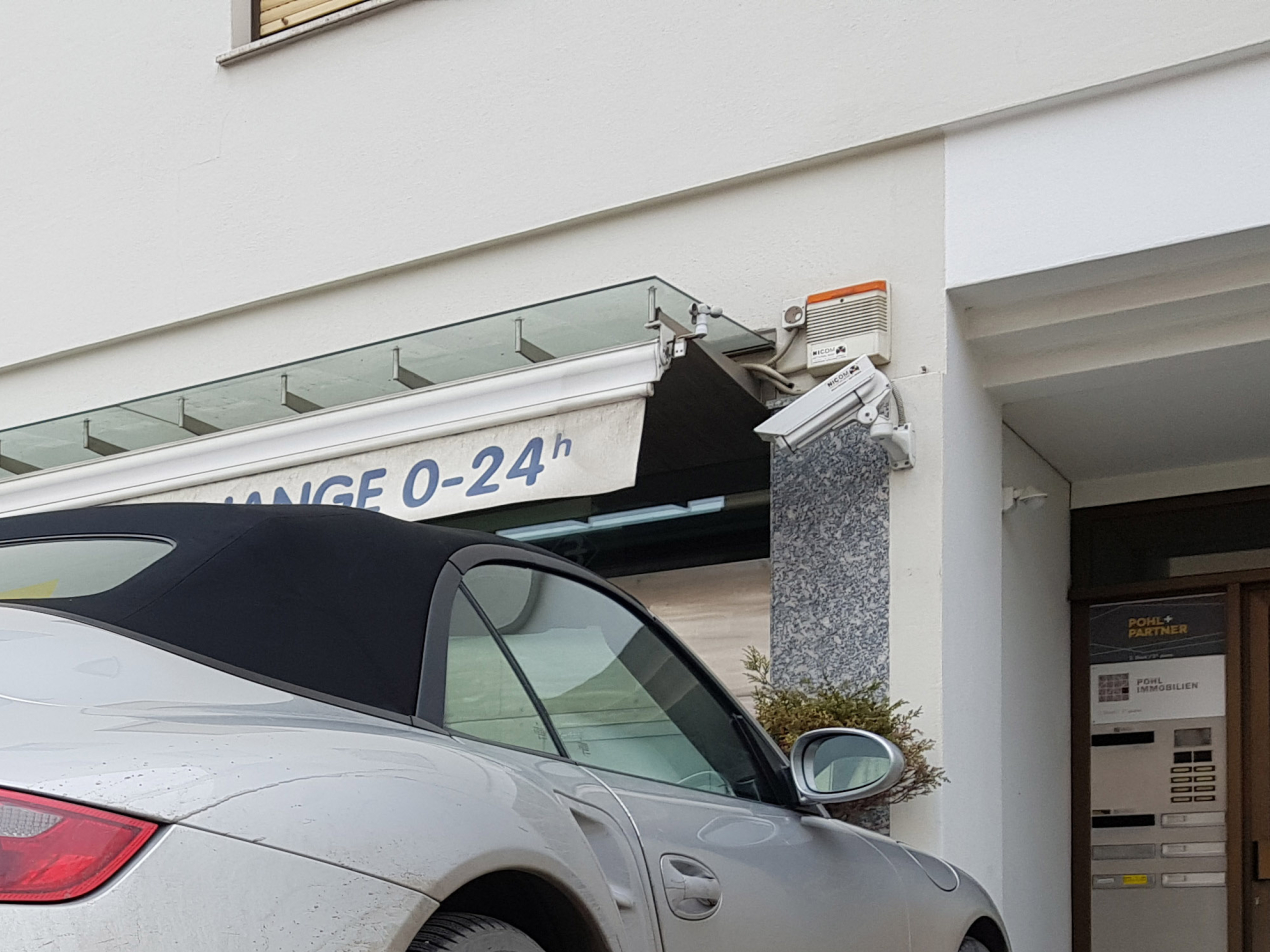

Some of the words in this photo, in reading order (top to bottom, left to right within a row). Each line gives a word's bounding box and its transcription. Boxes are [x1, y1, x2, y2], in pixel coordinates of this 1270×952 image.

[1128, 623, 1189, 639] PARTNER
[1136, 676, 1164, 686] POHL
[1136, 681, 1199, 694] IMMOBILIEN
